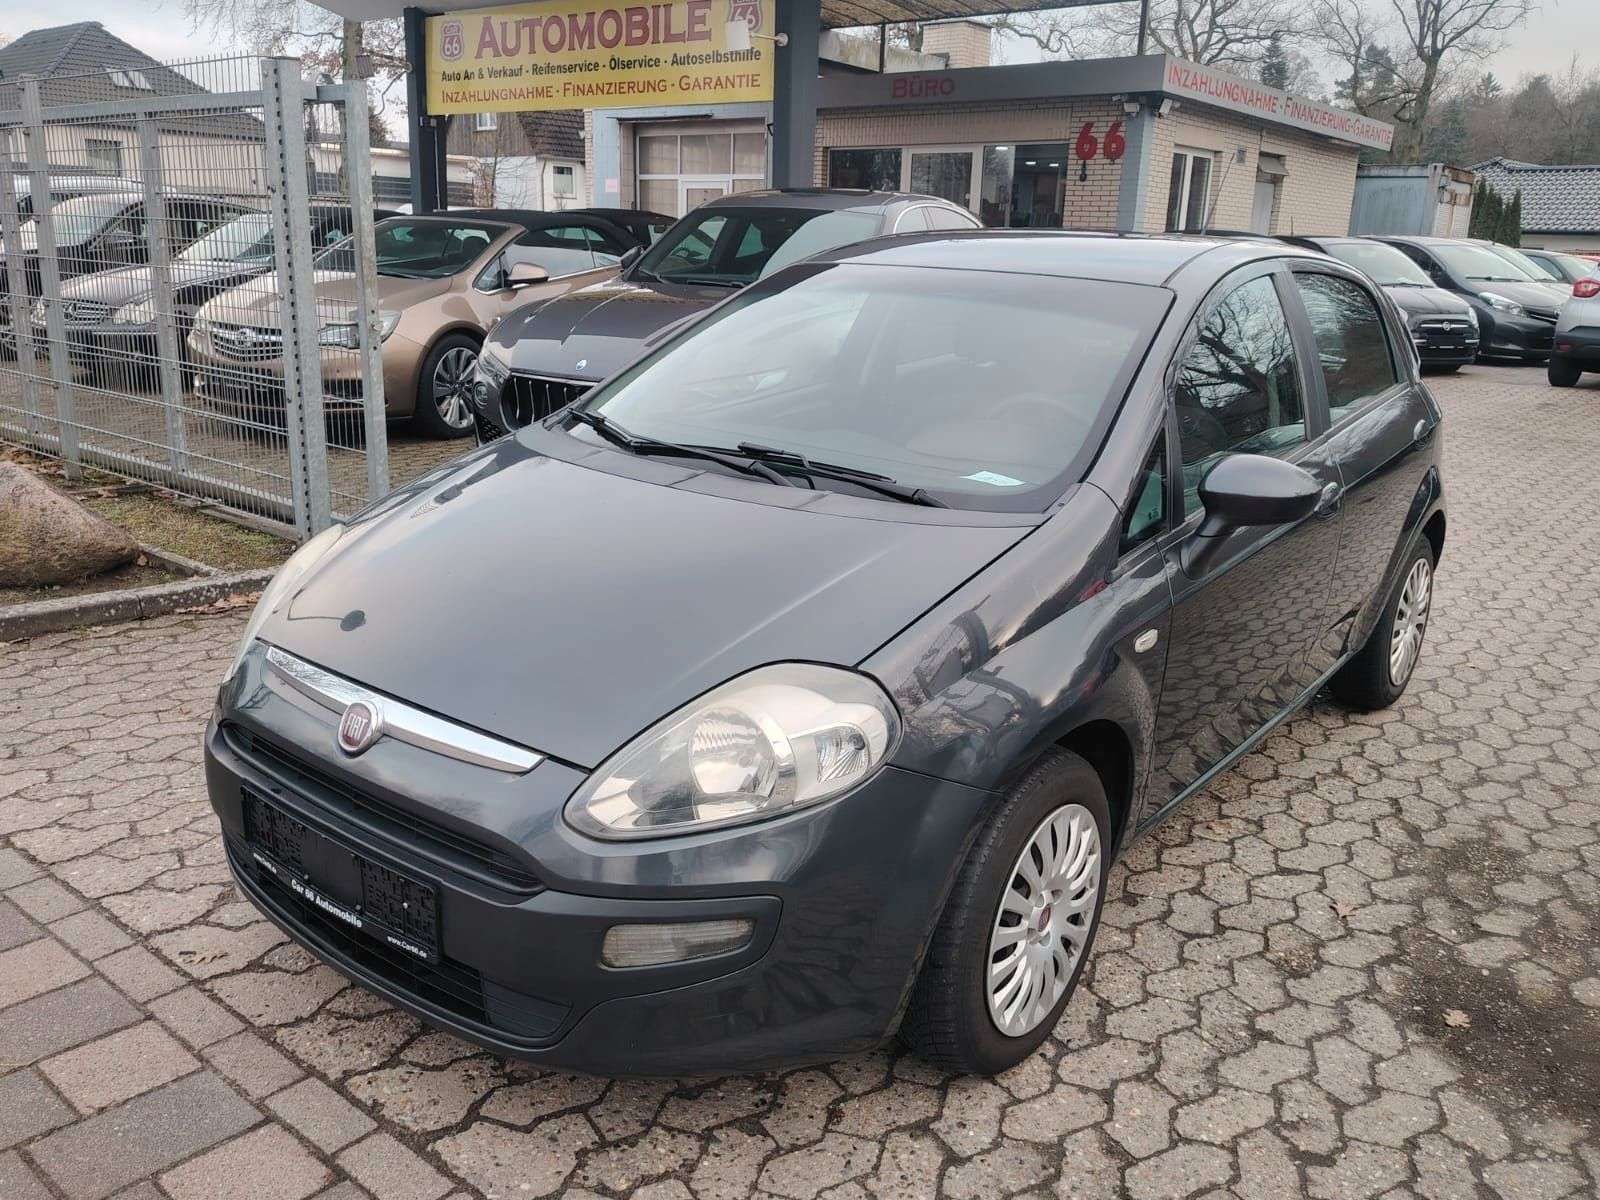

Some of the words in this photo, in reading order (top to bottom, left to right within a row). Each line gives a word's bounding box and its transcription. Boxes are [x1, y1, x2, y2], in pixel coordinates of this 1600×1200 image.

[445, 36, 460, 55] 66
[474, 1, 712, 59] AUTOMOBILE
[441, 70, 461, 82] Auto
[463, 69, 475, 81] An
[478, 68, 484, 79] &
[487, 65, 523, 79] Verkauf
[532, 60, 600, 76] Reifenservice
[609, 54, 661, 70] Ölservice
[671, 47, 761, 67] Autoselbsthilfe
[442, 86, 554, 104] INZAHLUNGNAHME
[563, 79, 667, 97] FINANZIERUNG
[679, 74, 761, 92] GARANTIE
[892, 76, 956, 98] BÜRO
[1168, 64, 1278, 113] INZAHLUNGNAHME
[1075, 120, 1126, 161] 66
[344, 712, 369, 741] FIAT
[291, 879, 304, 894] Car
[315, 896, 362, 928] Automobile
